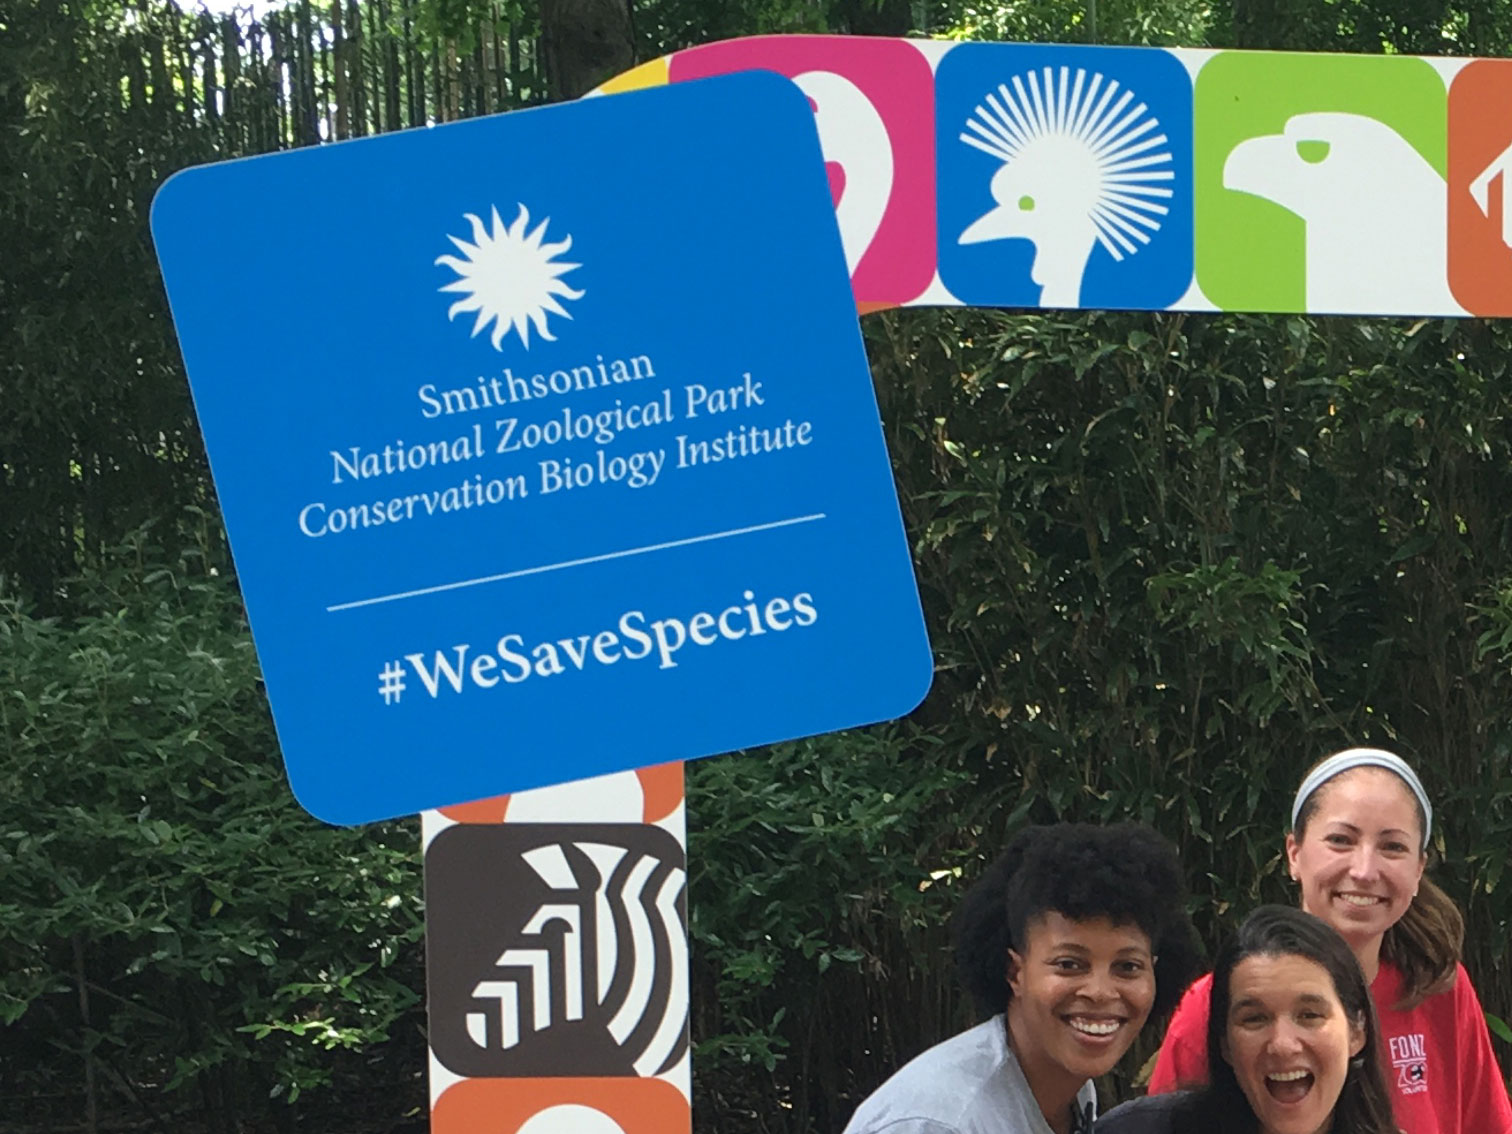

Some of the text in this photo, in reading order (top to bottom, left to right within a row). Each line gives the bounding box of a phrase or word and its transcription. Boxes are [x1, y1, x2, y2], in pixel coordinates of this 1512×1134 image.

[330, 372, 765, 485] National Zoological Park
[418, 354, 656, 418] Smithsonian
[299, 421, 813, 537] Conservation Biology Institute
[378, 590, 818, 705] #WeSaveSpecies
[1388, 1033, 1427, 1060] FONZ
